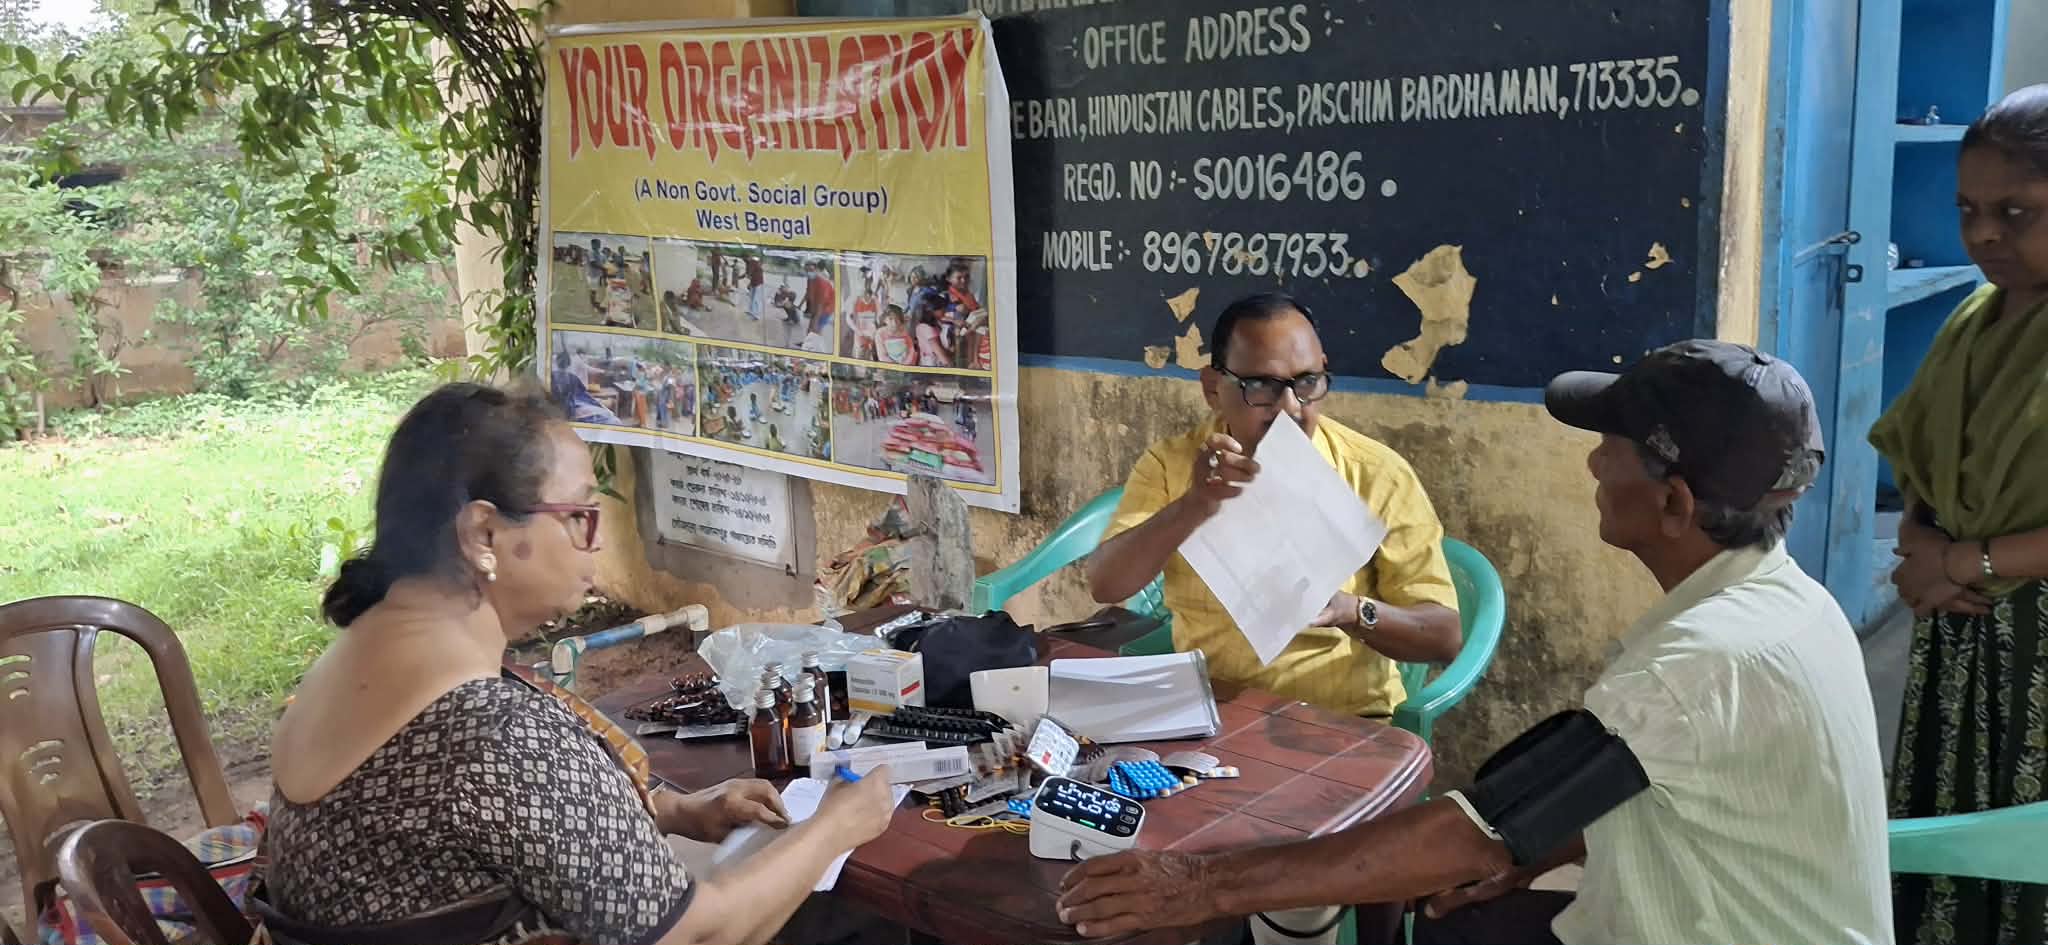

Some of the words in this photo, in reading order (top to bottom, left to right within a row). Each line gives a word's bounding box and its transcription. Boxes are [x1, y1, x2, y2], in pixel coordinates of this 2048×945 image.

[1083, 21, 1167, 69] OFFICE
[1185, 4, 1311, 63] ADDRESS
[559, 43, 656, 161] YOUR
[659, 27, 975, 162] ORGANIZATION
[634, 178, 653, 202] (A
[656, 182, 690, 202] Non
[695, 180, 742, 205] Govt.
[748, 182, 807, 207] Social
[814, 185, 889, 214] Group)
[1063, 162, 1122, 202] REGD.
[1130, 160, 1162, 200] NO
[1193, 150, 1366, 201] S0016486
[696, 208, 740, 231] West
[746, 212, 812, 239] Bengal
[1042, 230, 1112, 270] MOBILE
